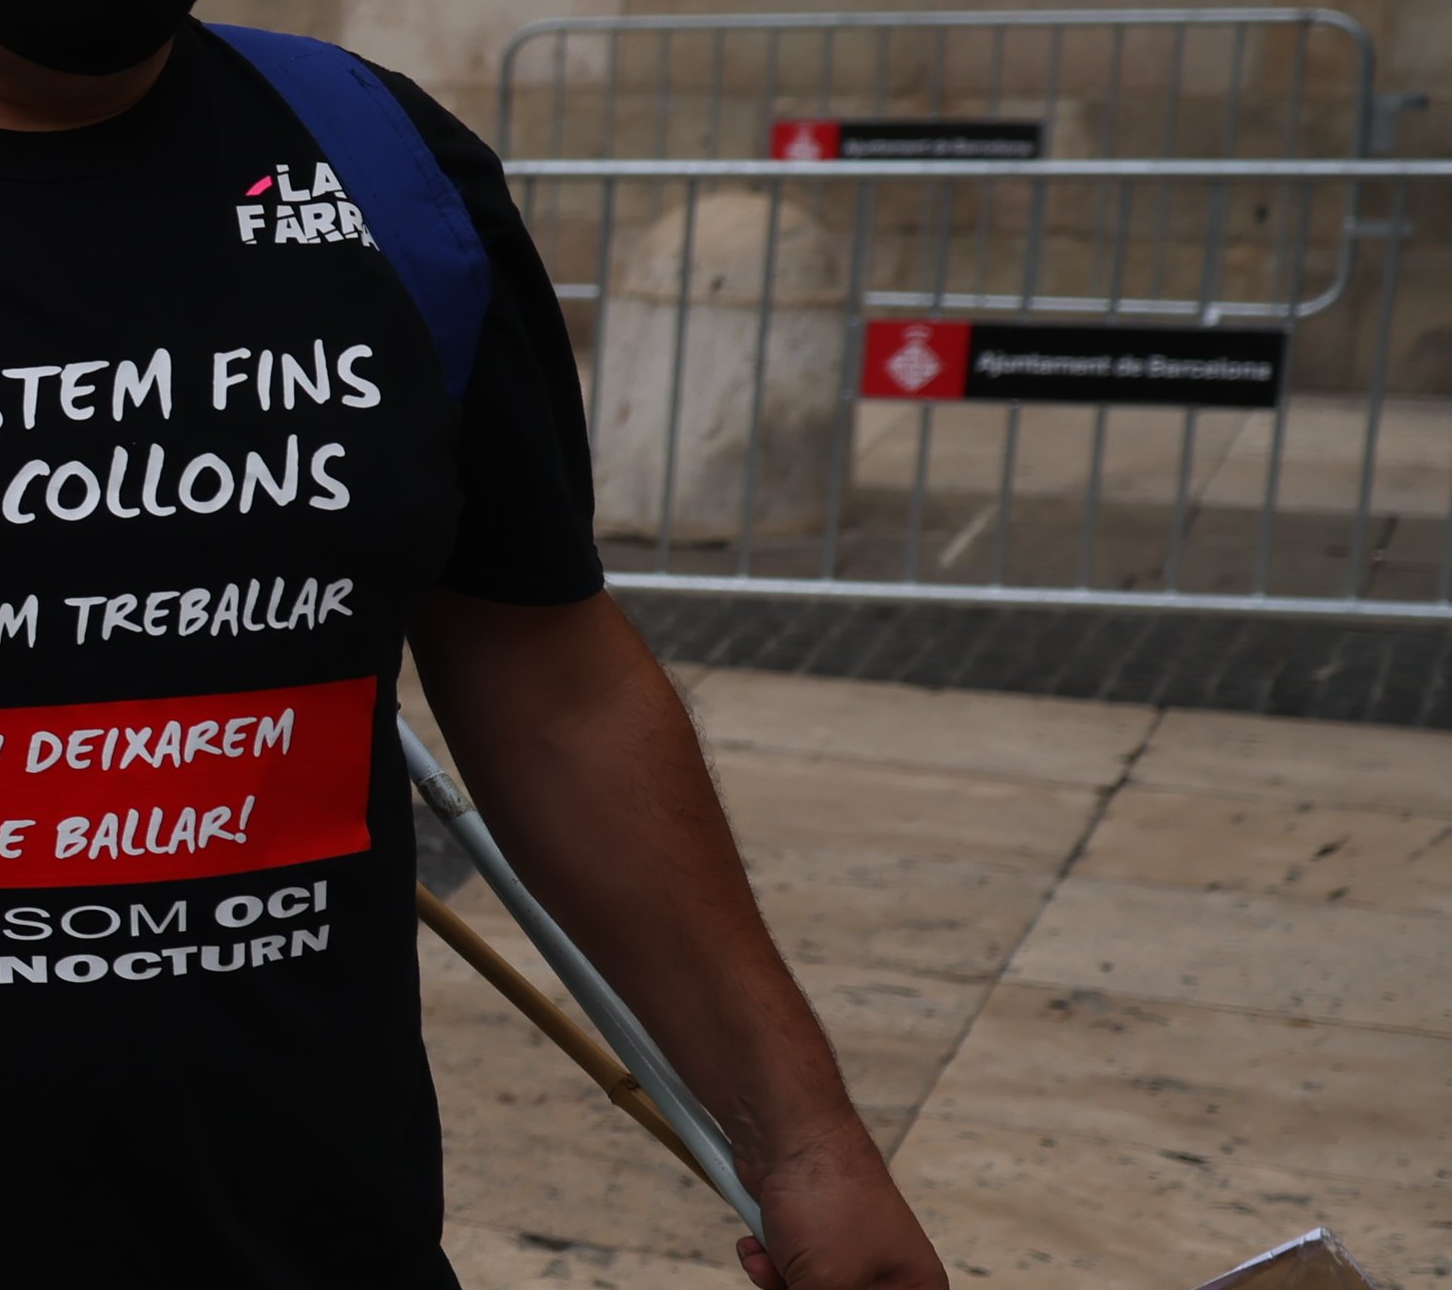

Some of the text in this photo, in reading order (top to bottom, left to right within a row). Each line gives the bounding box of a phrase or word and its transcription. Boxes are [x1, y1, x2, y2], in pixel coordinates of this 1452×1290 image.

[276, 162, 348, 202] LA
[212, 338, 382, 410] FINS
[1, 434, 351, 525] COLLONS
[64, 576, 354, 645] TREBALLAR
[25, 708, 295, 774] DEIXAREM
[54, 795, 256, 860] BALLAR!
[2, 880, 330, 941] SOM OCI
